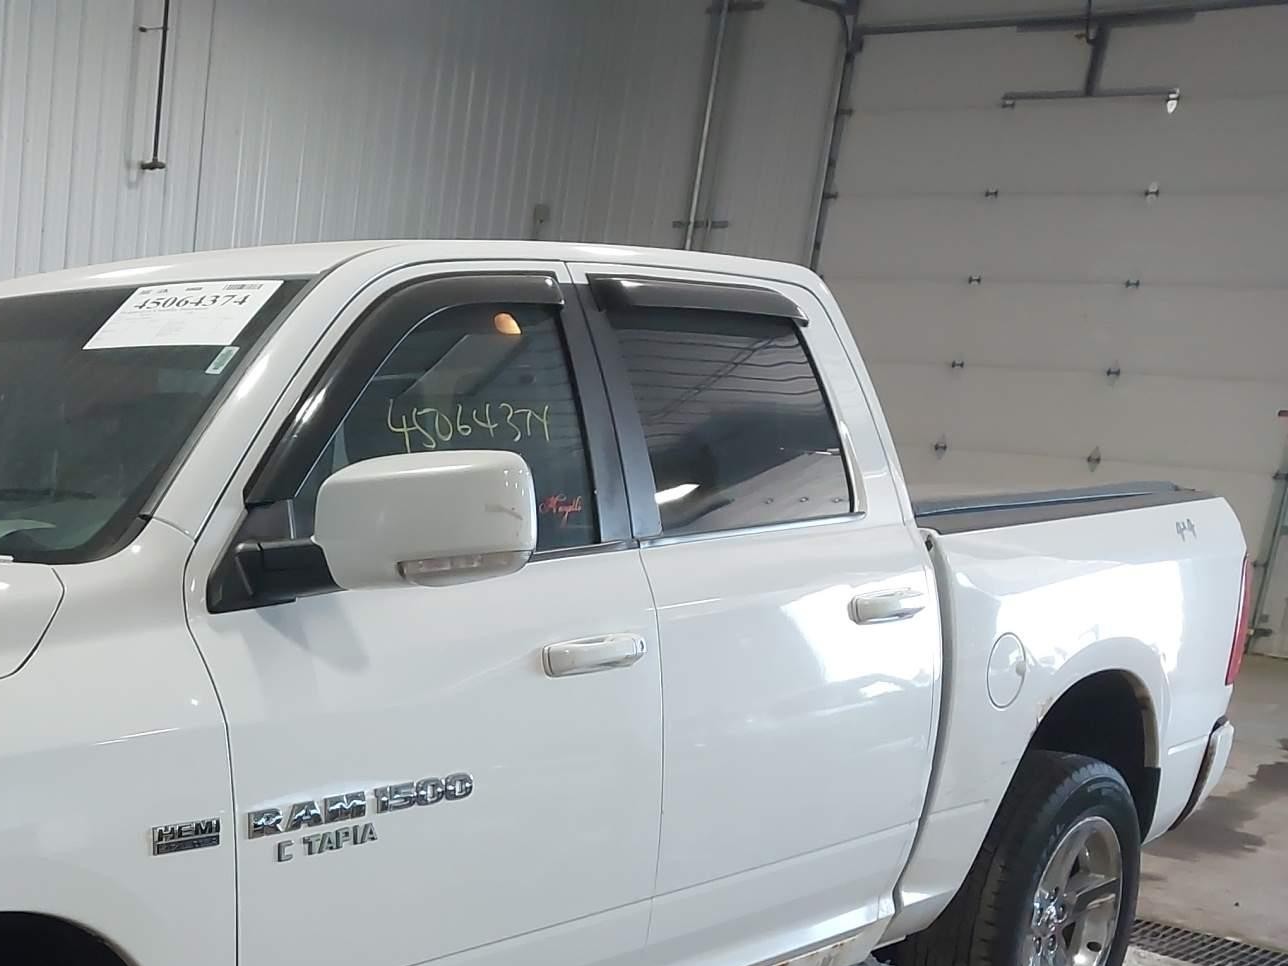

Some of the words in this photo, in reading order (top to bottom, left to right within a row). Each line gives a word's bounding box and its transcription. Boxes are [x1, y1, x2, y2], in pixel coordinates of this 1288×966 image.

[133, 294, 251, 310] 45064374
[387, 399, 550, 454] 45064374
[247, 791, 367, 839] RAM
[373, 772, 474, 814] 1500
[157, 818, 221, 842] HEMI
[276, 840, 295, 862] C
[302, 822, 378, 856] TAPIA
